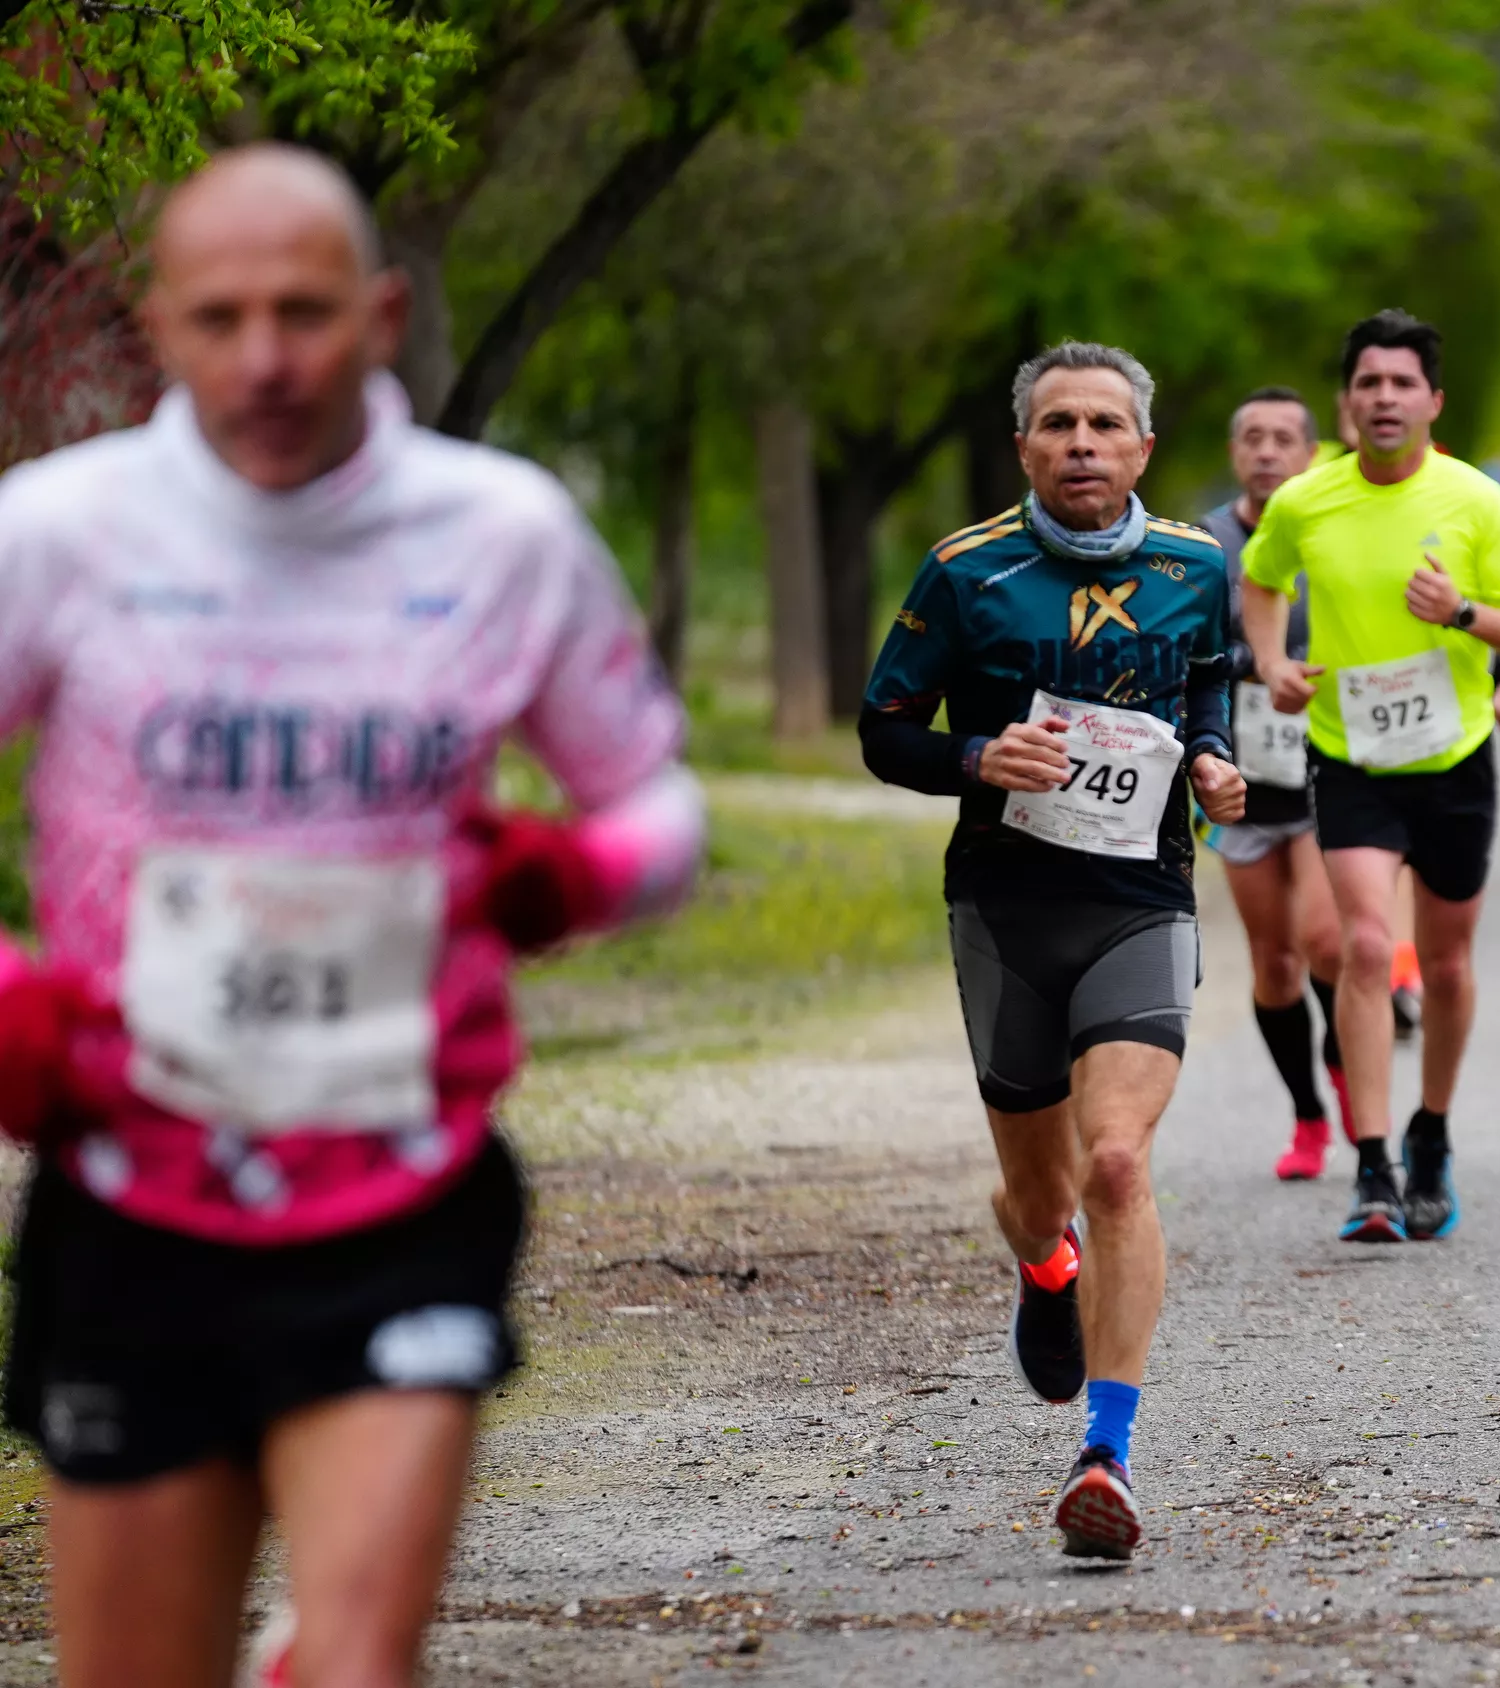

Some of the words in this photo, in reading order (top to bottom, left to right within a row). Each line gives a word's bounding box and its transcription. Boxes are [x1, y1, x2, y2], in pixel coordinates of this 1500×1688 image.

[1148, 552, 1187, 582] SIG
[1068, 575, 1142, 652] IX
[1371, 693, 1434, 732] 972
[1059, 755, 1139, 804] 749
